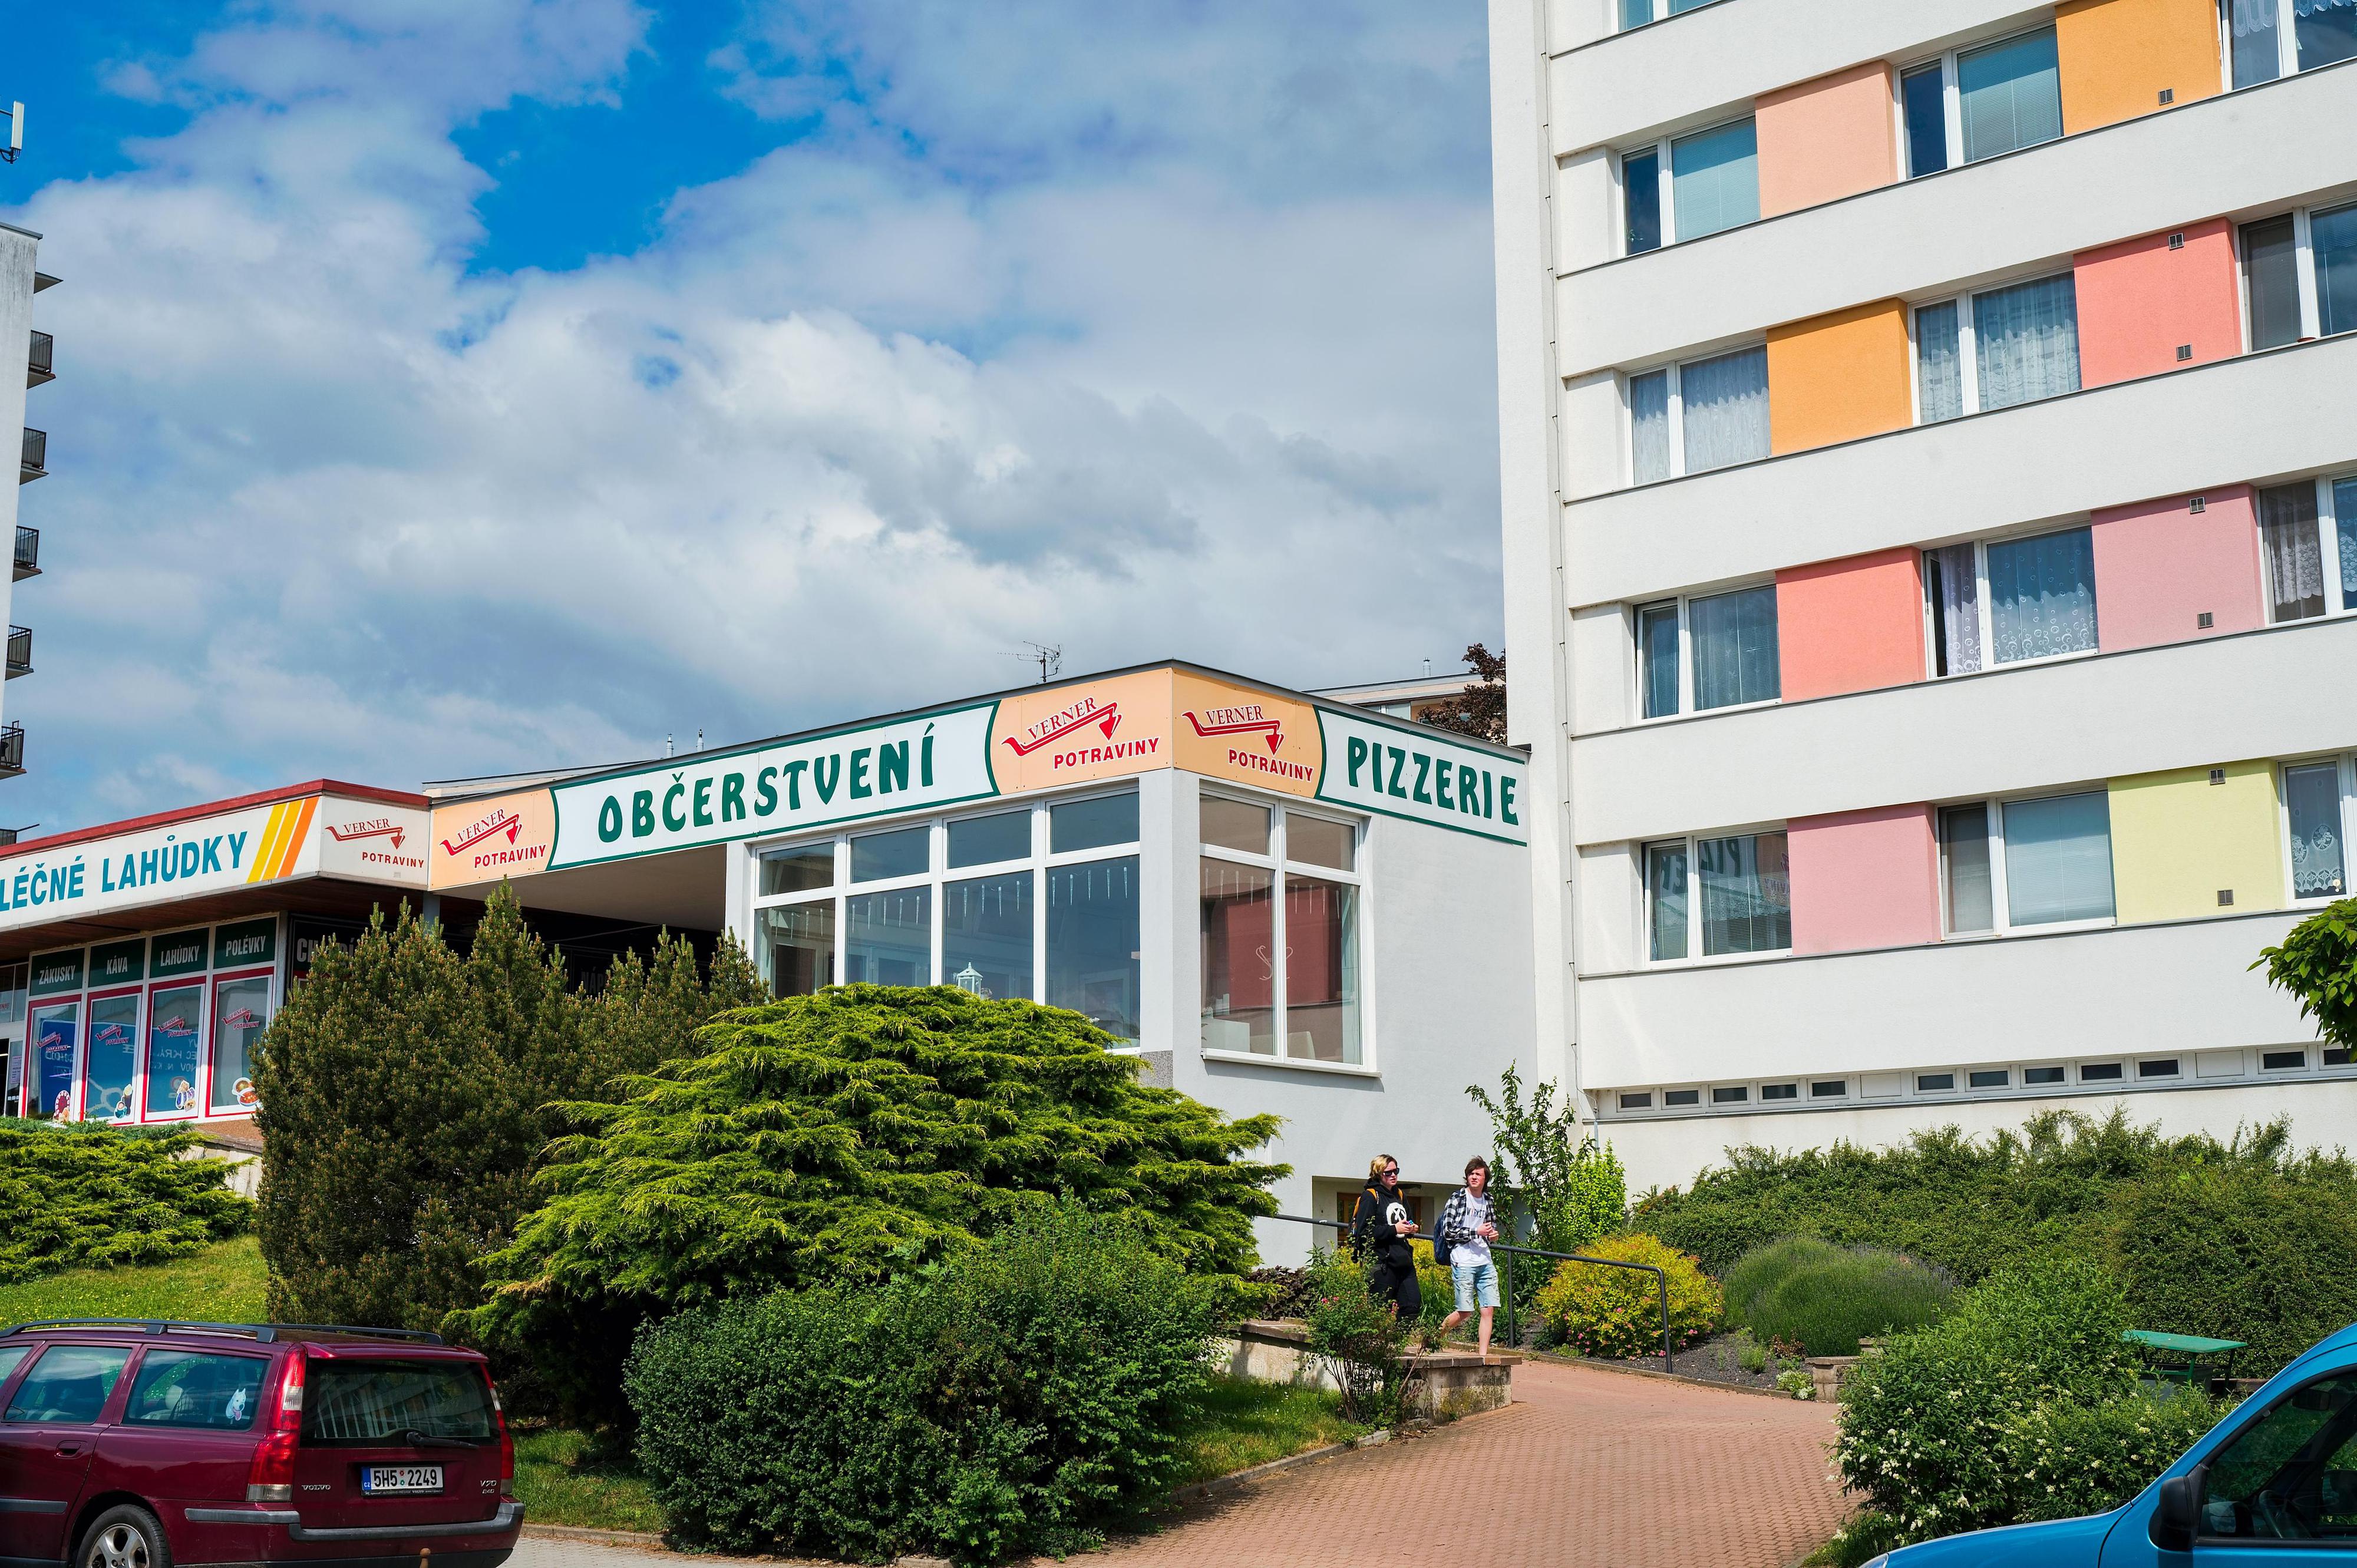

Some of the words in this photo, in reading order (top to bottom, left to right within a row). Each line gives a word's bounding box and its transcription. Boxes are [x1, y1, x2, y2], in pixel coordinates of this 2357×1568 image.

[1028, 697, 1097, 740] VERNER
[1206, 705, 1264, 725] VERNER
[1054, 737, 1159, 769] POTRAVINY
[1229, 748, 1313, 781] POTRAVINY
[598, 722, 935, 843] OBČERSTVENÍ
[1348, 737, 1519, 826] PIZZERIE
[344, 818, 390, 834] VERNER
[457, 808, 505, 843] VERNER
[101, 831, 247, 893] LAHŮDKY
[362, 851, 424, 869] POTRAVINY
[474, 845, 547, 869] POTRAVINY
[226, 935, 266, 958] POLÉVKY
[39, 965, 76, 985] ZÁKUSKY
[106, 955, 128, 975] KÁVA
[233, 1021, 259, 1030] POTRAVINY
[374, 1470, 398, 1487] 5H5
[408, 1469, 437, 1486] 2249
